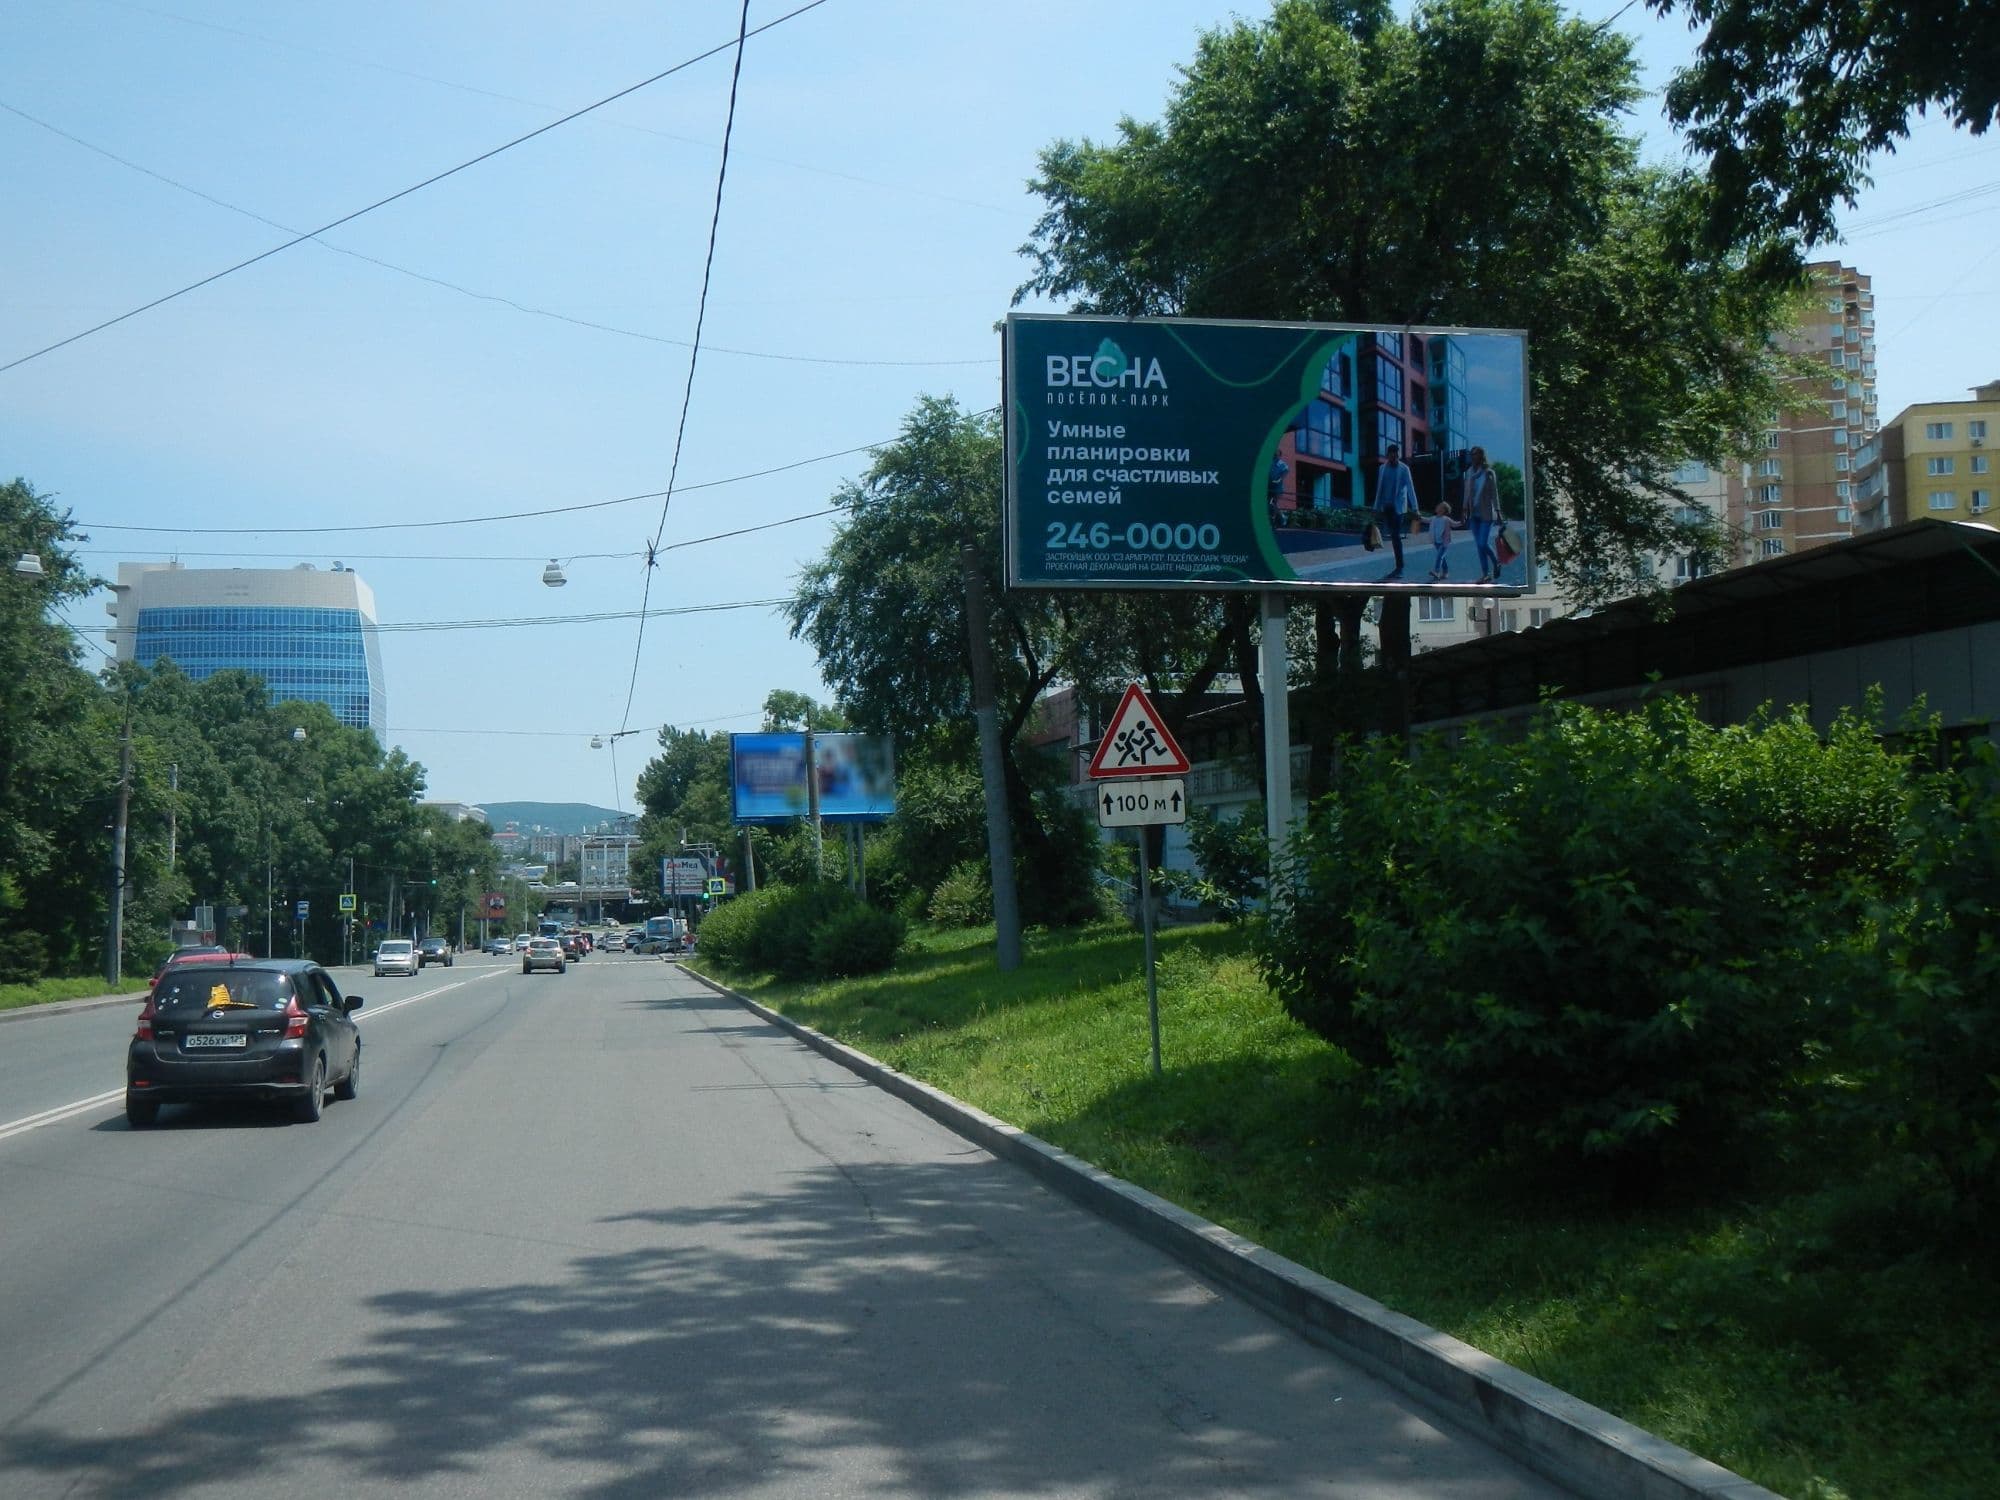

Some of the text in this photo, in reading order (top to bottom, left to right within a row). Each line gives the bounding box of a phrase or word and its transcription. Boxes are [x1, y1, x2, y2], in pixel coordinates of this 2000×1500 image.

[1046, 354, 1168, 390] ВЕСНА
[1047, 420, 1127, 439] Умные
[1047, 446, 1191, 465] планировки
[1046, 468, 1220, 485] для счастливых
[1047, 486, 1122, 504] семей
[1046, 522, 1221, 550] 246-0000
[1116, 794, 1149, 812] 100
